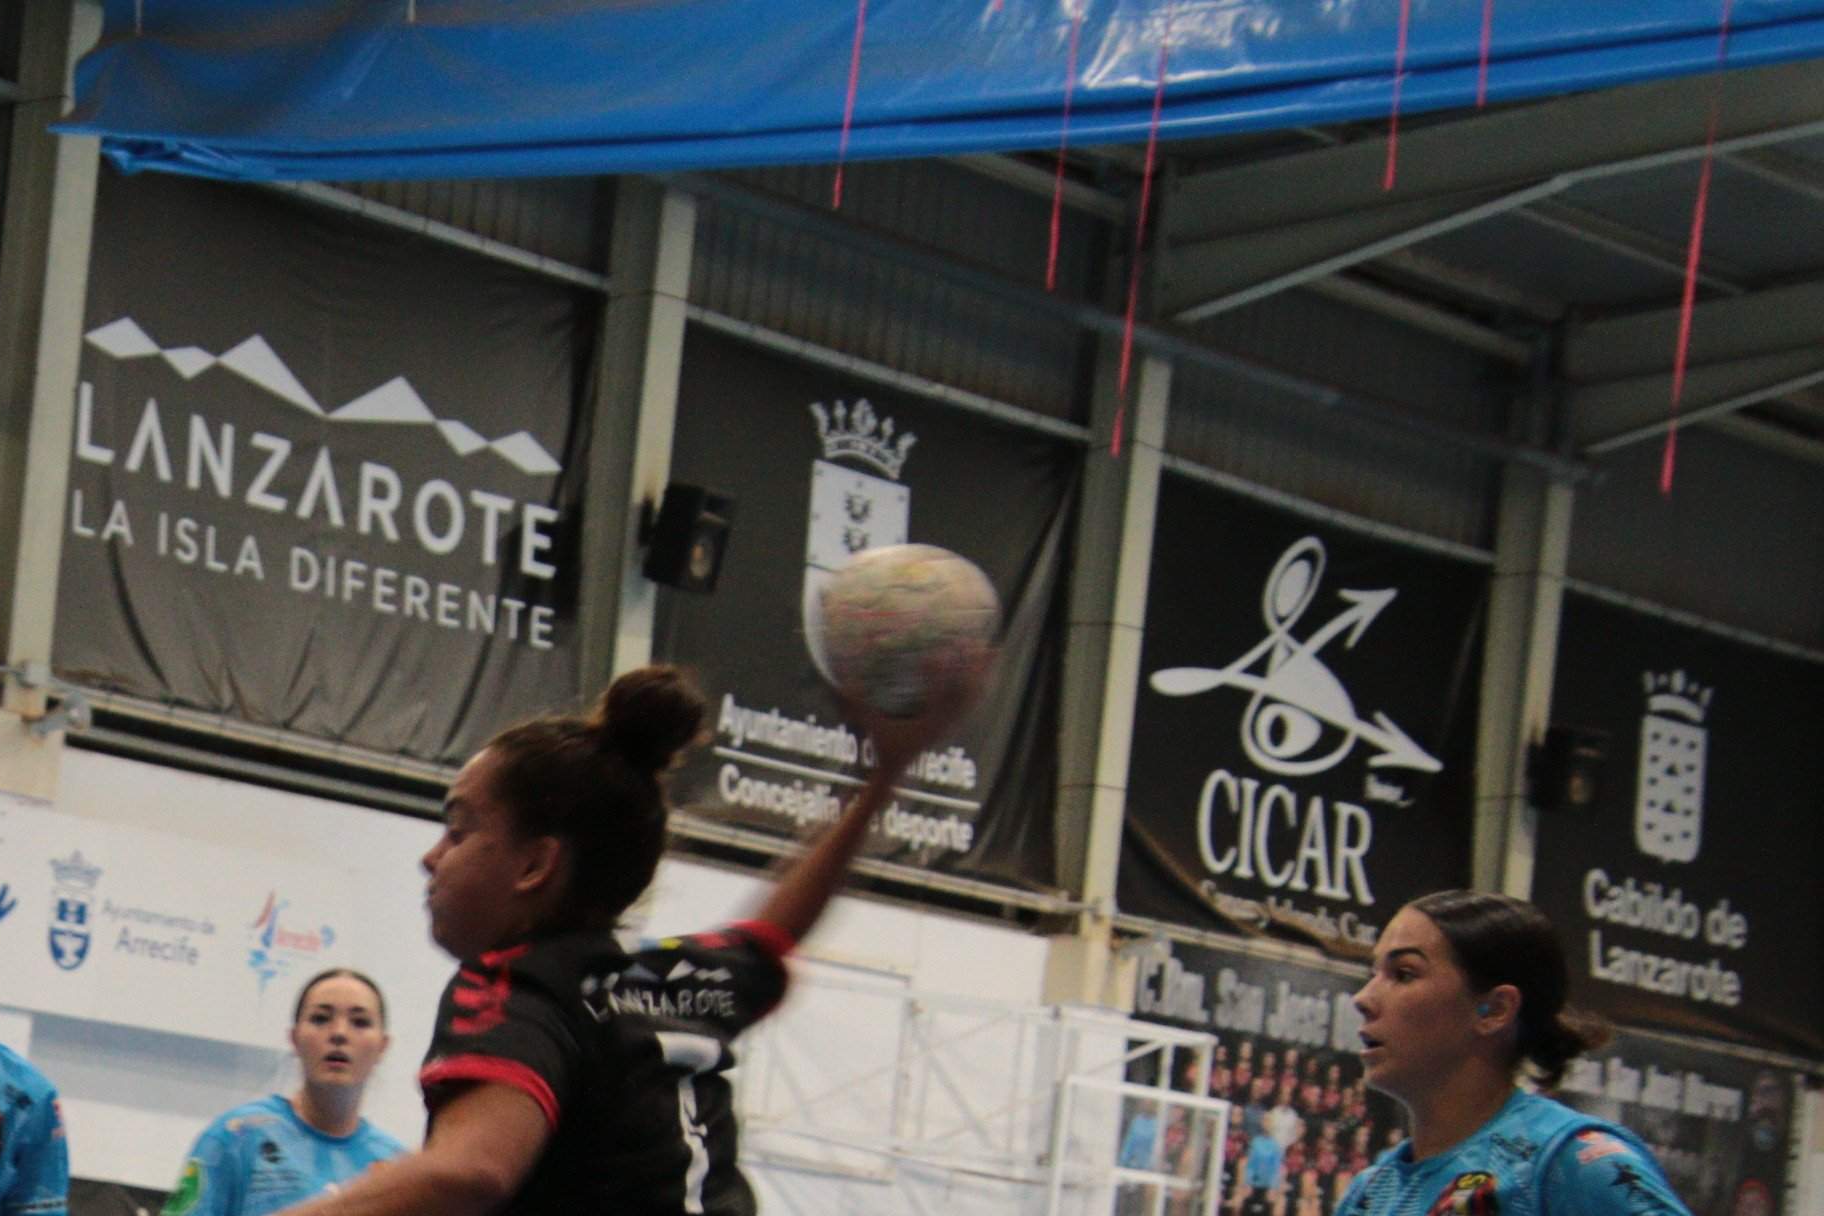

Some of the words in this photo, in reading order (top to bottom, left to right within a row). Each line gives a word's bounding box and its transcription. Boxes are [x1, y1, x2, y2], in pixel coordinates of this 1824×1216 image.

[77, 381, 561, 581] LANZAROTE
[73, 489, 134, 546] LA
[158, 512, 265, 580] ISLA
[290, 547, 555, 651] DIFERENTE
[717, 694, 858, 763] Ayuntamiento
[883, 801, 974, 851] deporte
[1197, 768, 1375, 905] CICAR
[1584, 868, 1701, 939] Cabildo
[1706, 898, 1748, 949] de
[581, 986, 736, 1024] LANZAROTE
[1589, 929, 1742, 1007] Lanzarote
